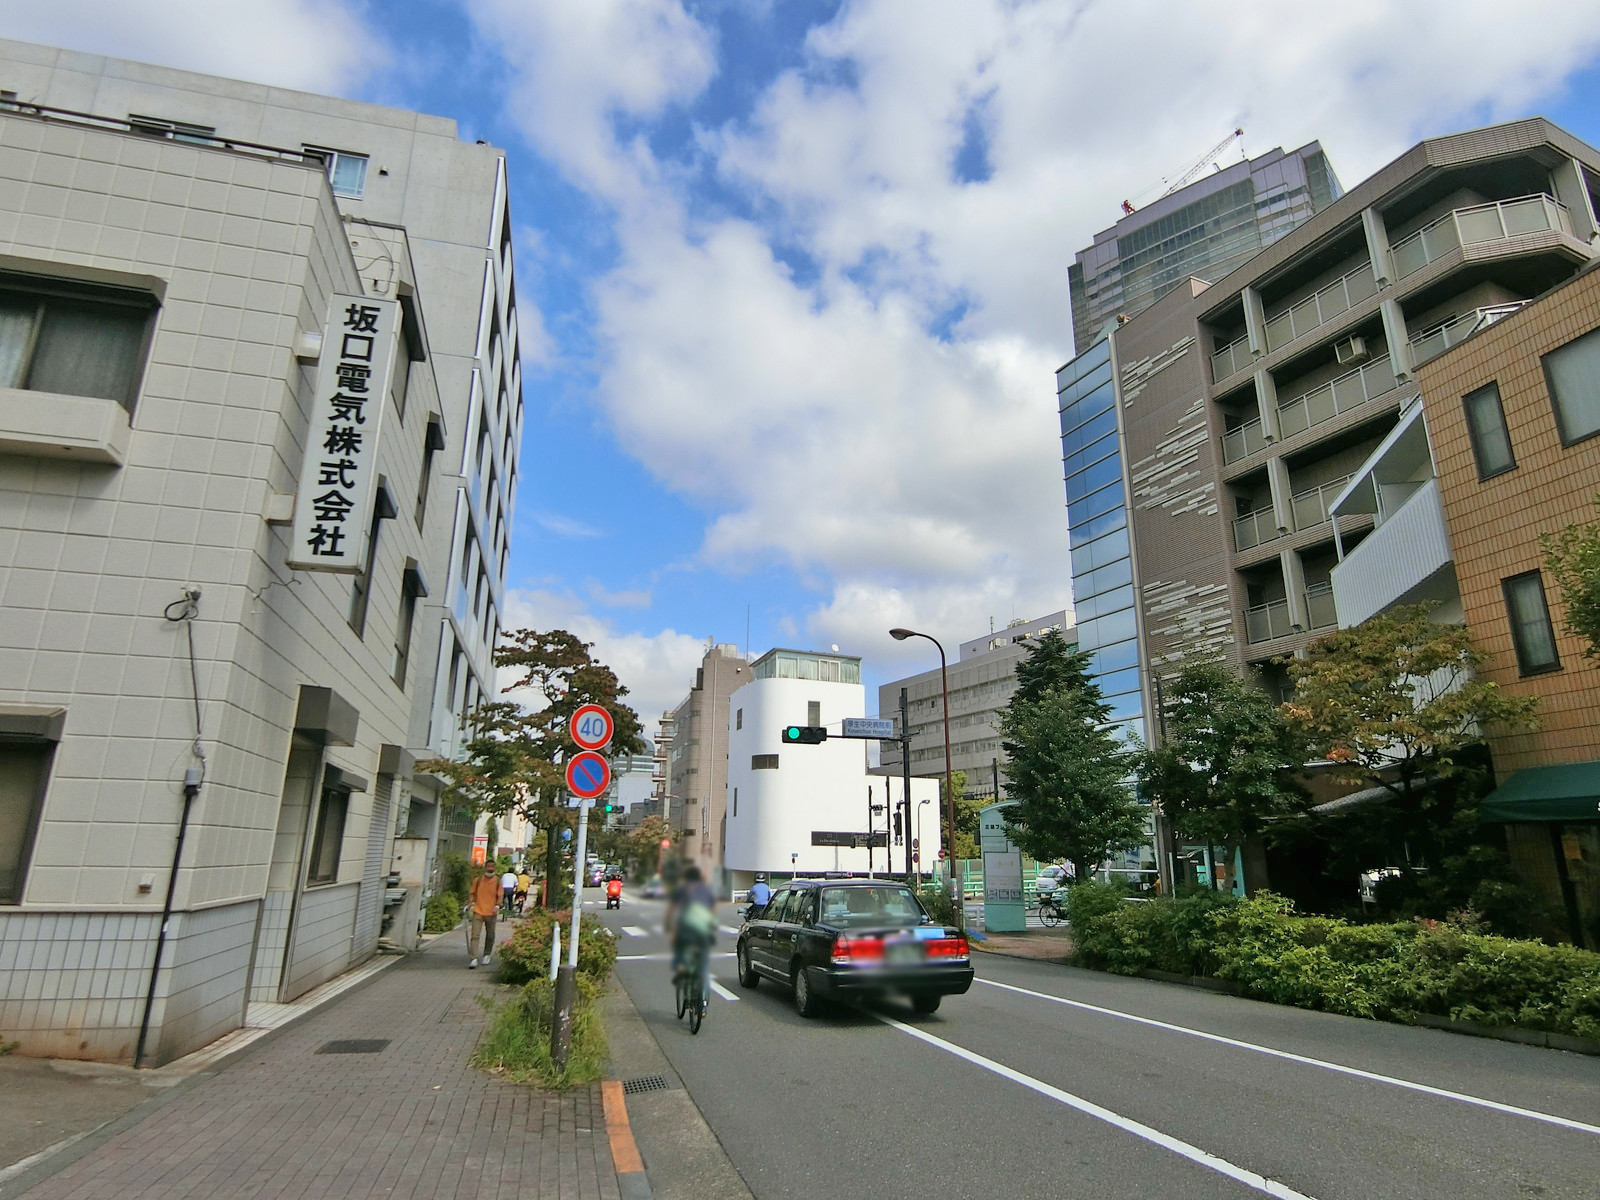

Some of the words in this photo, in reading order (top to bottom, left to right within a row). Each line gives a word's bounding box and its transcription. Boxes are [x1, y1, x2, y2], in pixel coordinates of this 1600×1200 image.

[307, 303, 381, 557] 坂口電気株式会社
[580, 718, 604, 736] 40
